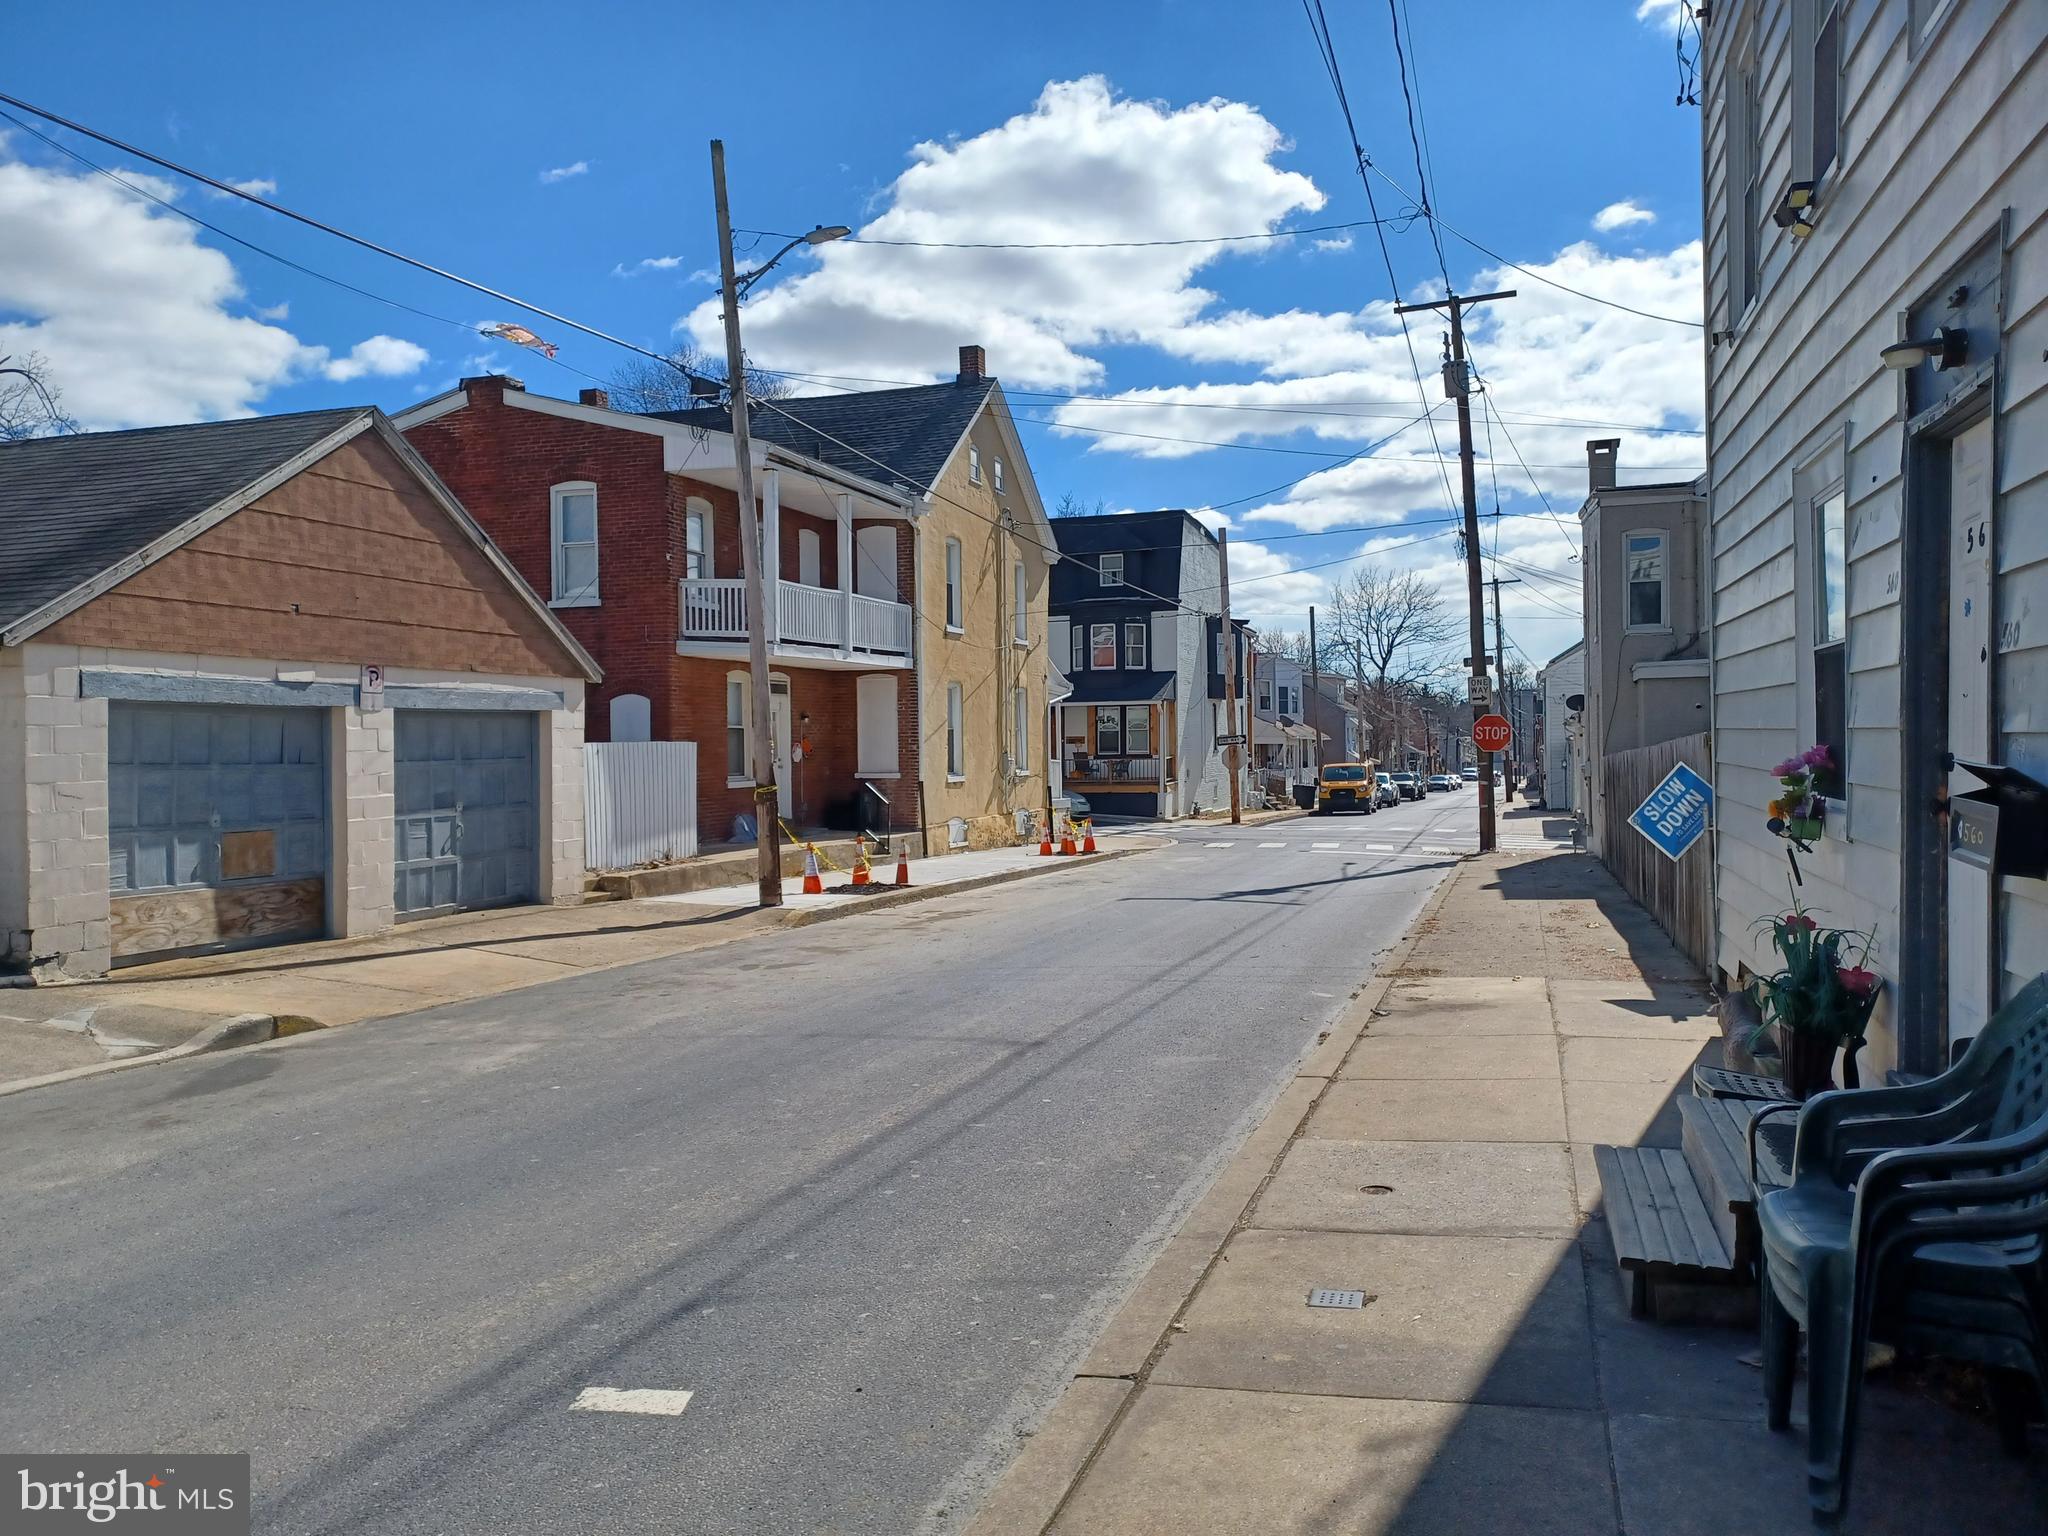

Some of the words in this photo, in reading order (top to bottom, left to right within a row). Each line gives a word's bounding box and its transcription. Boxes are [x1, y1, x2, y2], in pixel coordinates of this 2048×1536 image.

[1470, 678, 1489, 687] ONE
[1470, 686, 1489, 694] WAY
[1475, 726, 1509, 740] STOP
[1643, 777, 1686, 821] SLOW
[1656, 789, 1704, 837] DOWN
